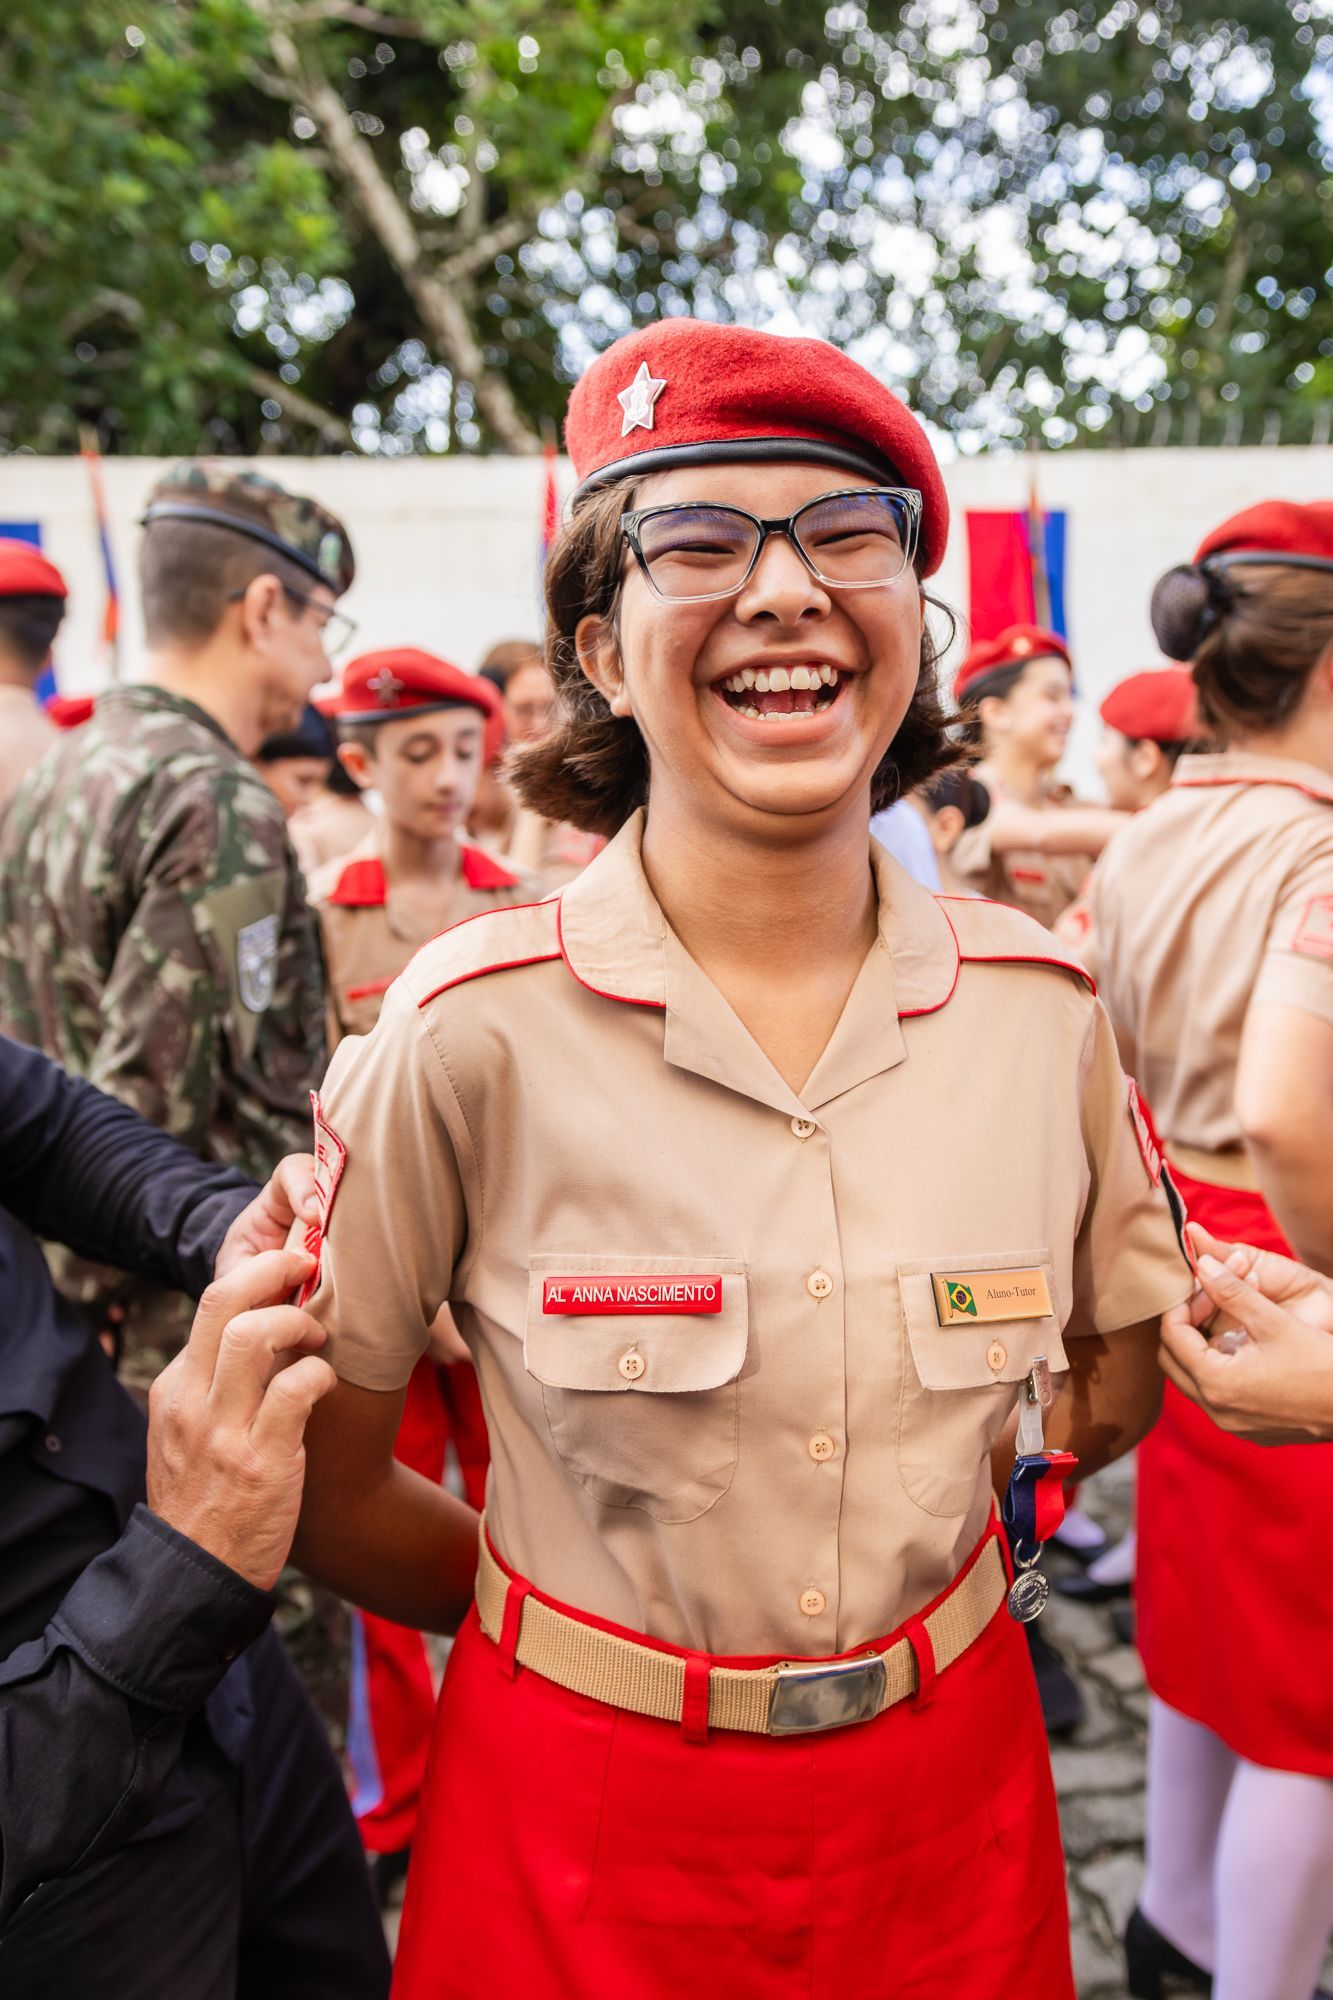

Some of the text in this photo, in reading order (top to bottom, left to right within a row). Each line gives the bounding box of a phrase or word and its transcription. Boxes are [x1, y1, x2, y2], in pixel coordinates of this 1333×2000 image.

[547, 1284, 716, 1303] AL ANNA NASCIMENTO
[986, 1286, 1037, 1300] Aluno-Tutor
